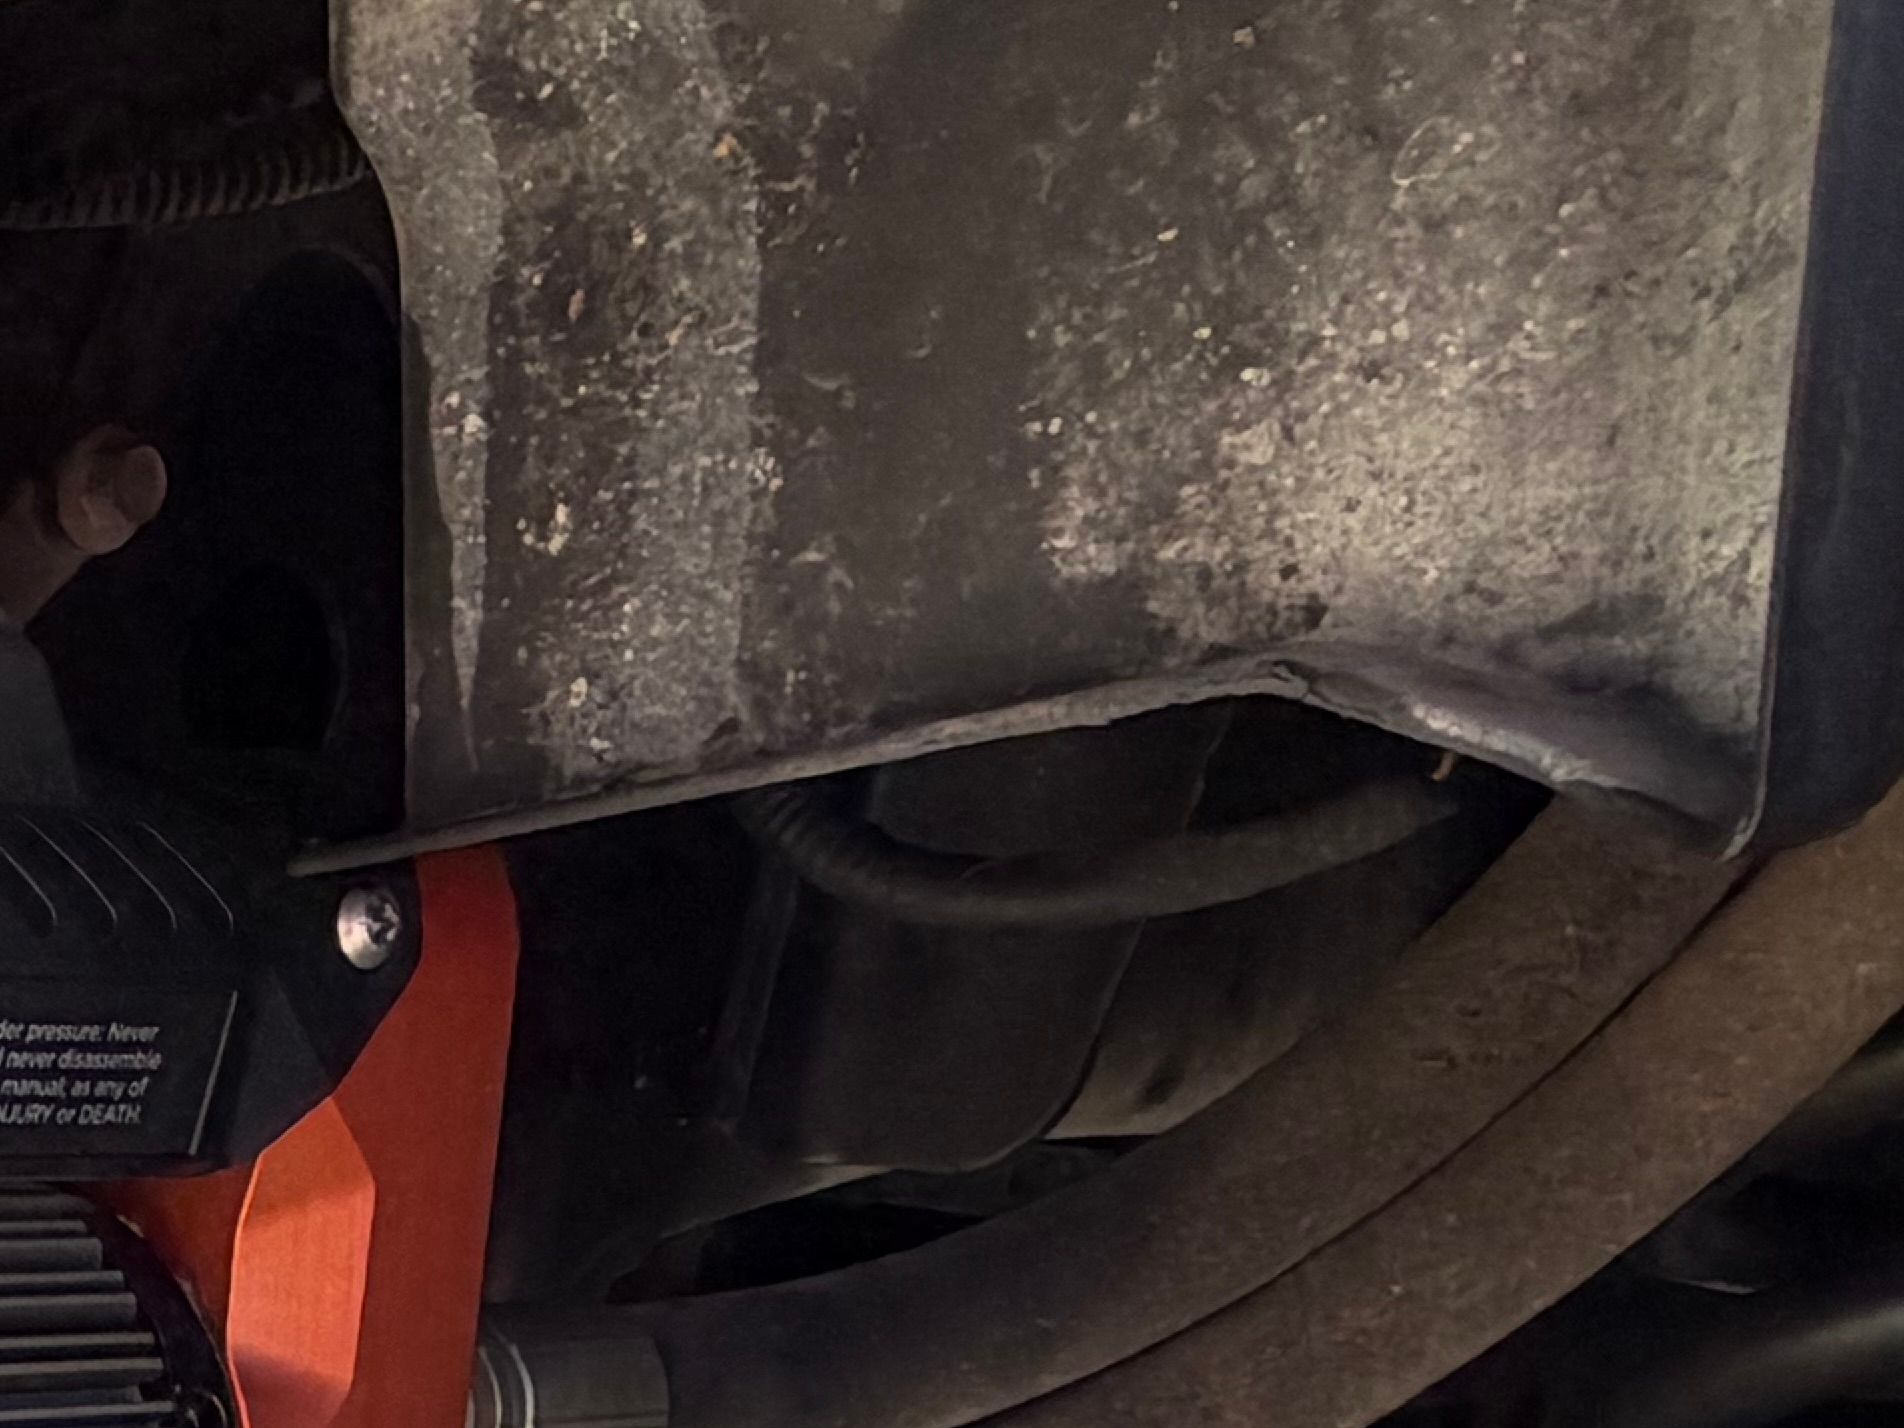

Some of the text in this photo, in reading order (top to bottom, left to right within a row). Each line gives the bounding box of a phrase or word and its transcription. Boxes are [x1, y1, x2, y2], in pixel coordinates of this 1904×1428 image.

[107, 1022, 159, 1042] Never
[6, 1051, 56, 1069] never
[57, 1049, 162, 1070] disassemble
[70, 1080, 91, 1097] as
[94, 1080, 128, 1101] any
[128, 1076, 151, 1097] of
[56, 1108, 77, 1124] or
